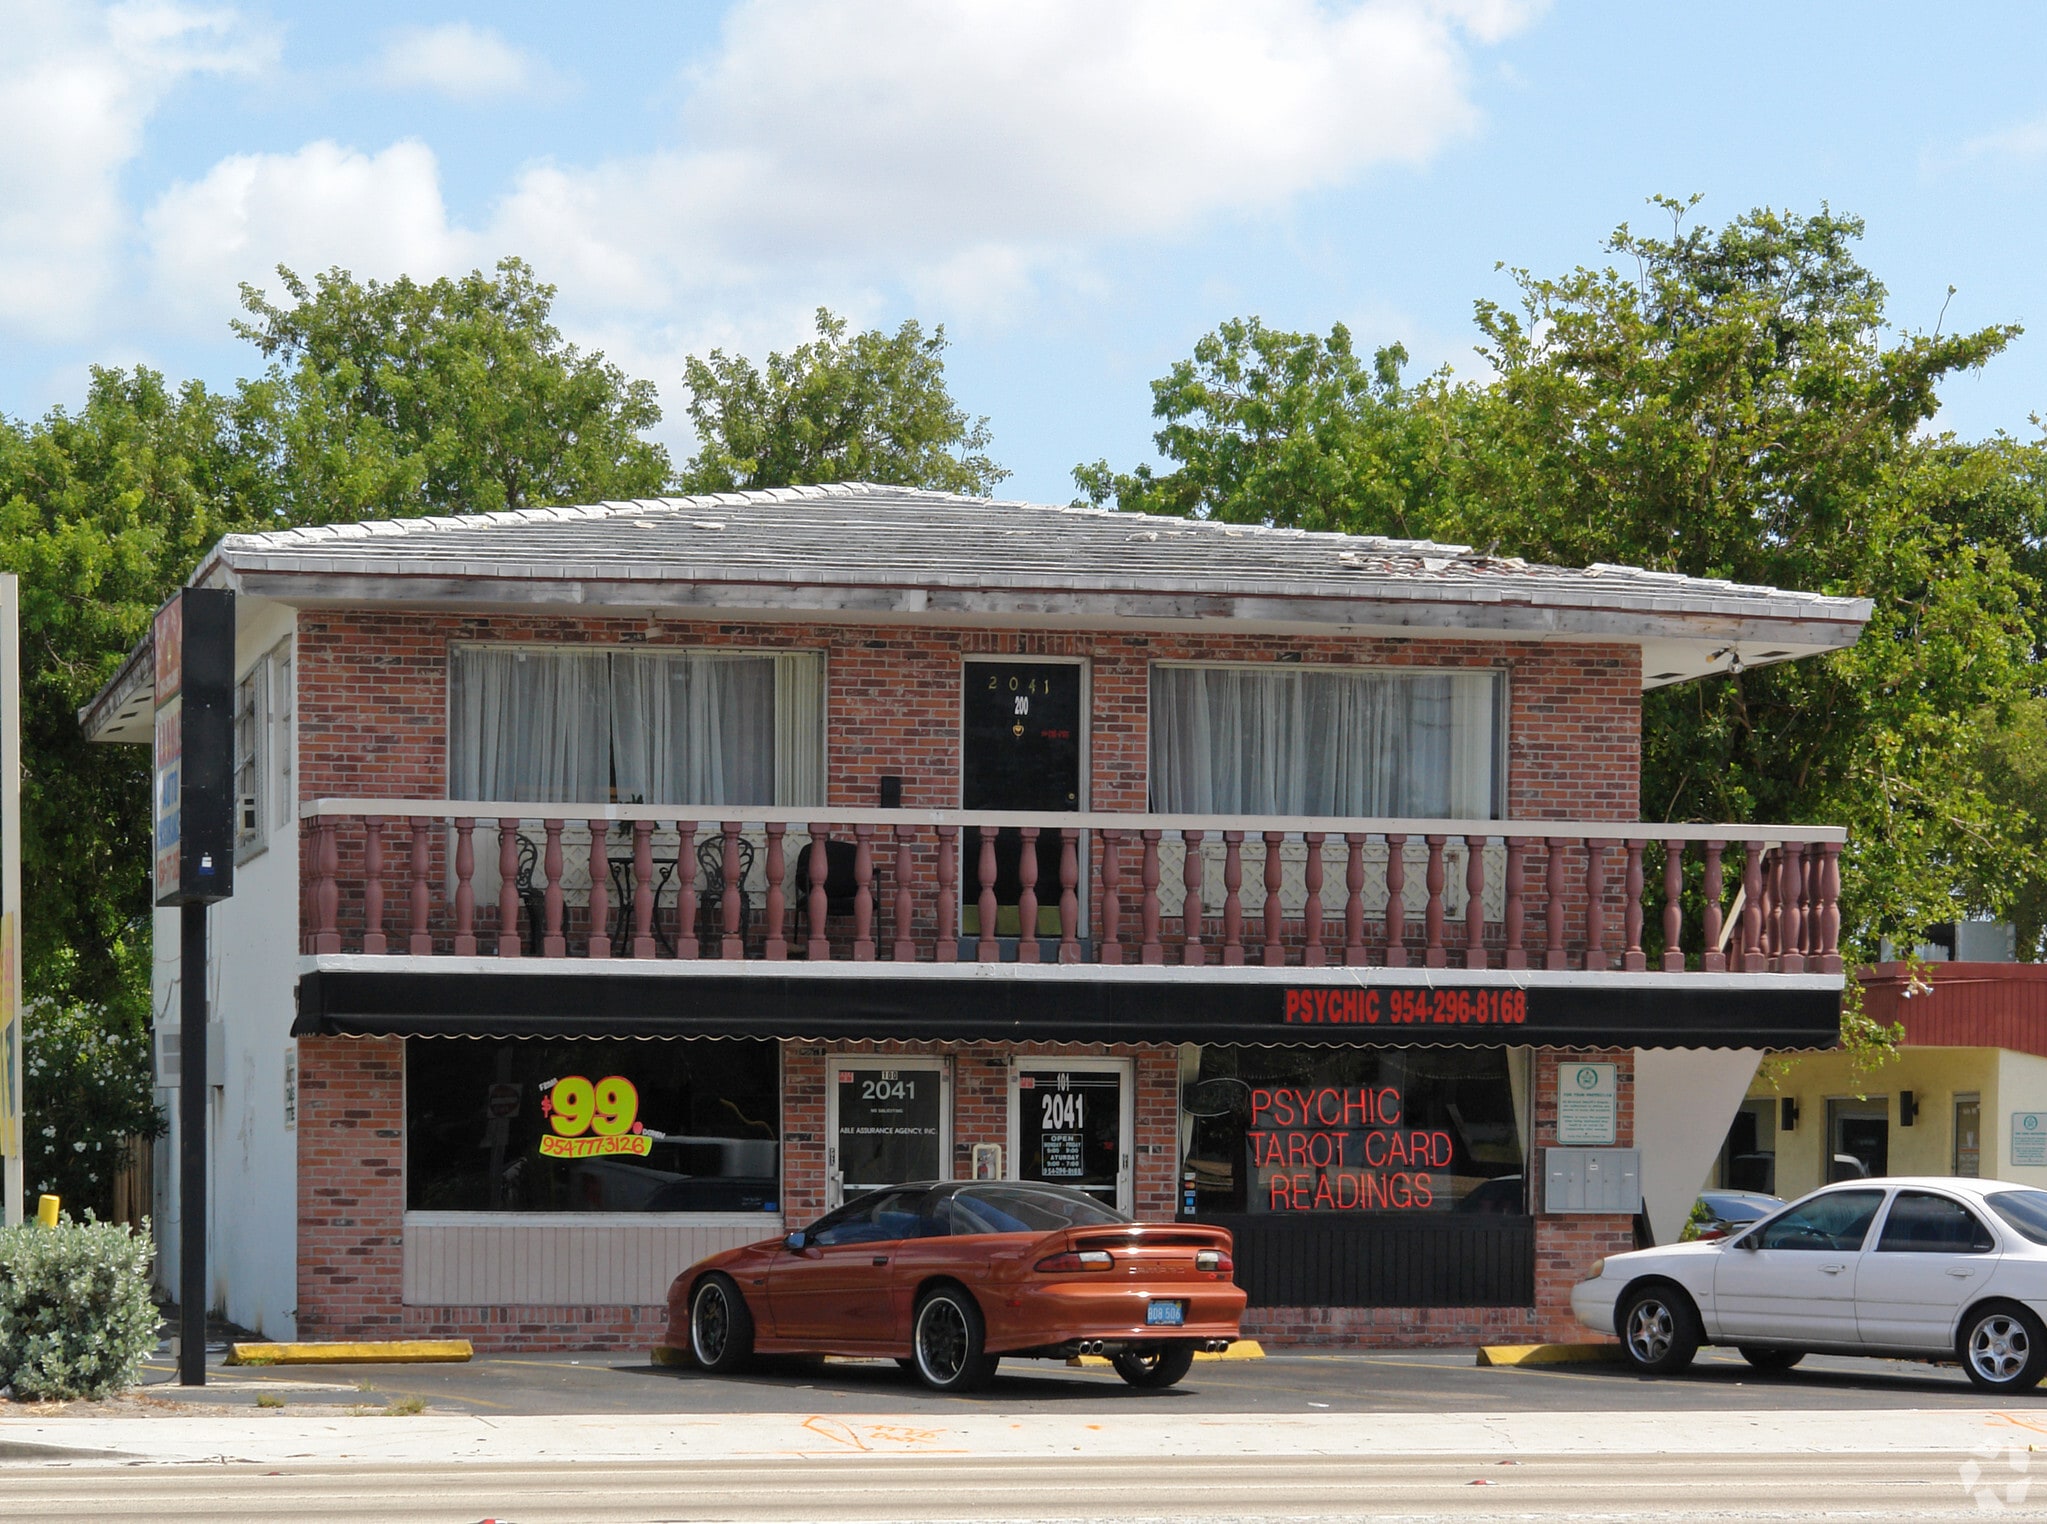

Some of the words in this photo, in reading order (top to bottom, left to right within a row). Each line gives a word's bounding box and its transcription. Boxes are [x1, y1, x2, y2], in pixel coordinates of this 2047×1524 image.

[988, 676, 1050, 695] 2041
[1014, 696, 1029, 716] 200
[1285, 989, 1380, 1024] PSYCHIC
[882, 1070, 898, 1080] 100
[1057, 1073, 1070, 1091] 101
[861, 1080, 915, 1100] 2041
[1042, 1094, 1084, 1130] 2041
[1251, 1087, 1400, 1126] PSYCHIC
[1249, 1132, 1348, 1168] TAROT
[1365, 1131, 1453, 1167] CARD
[1270, 1172, 1433, 1210] READINGS
